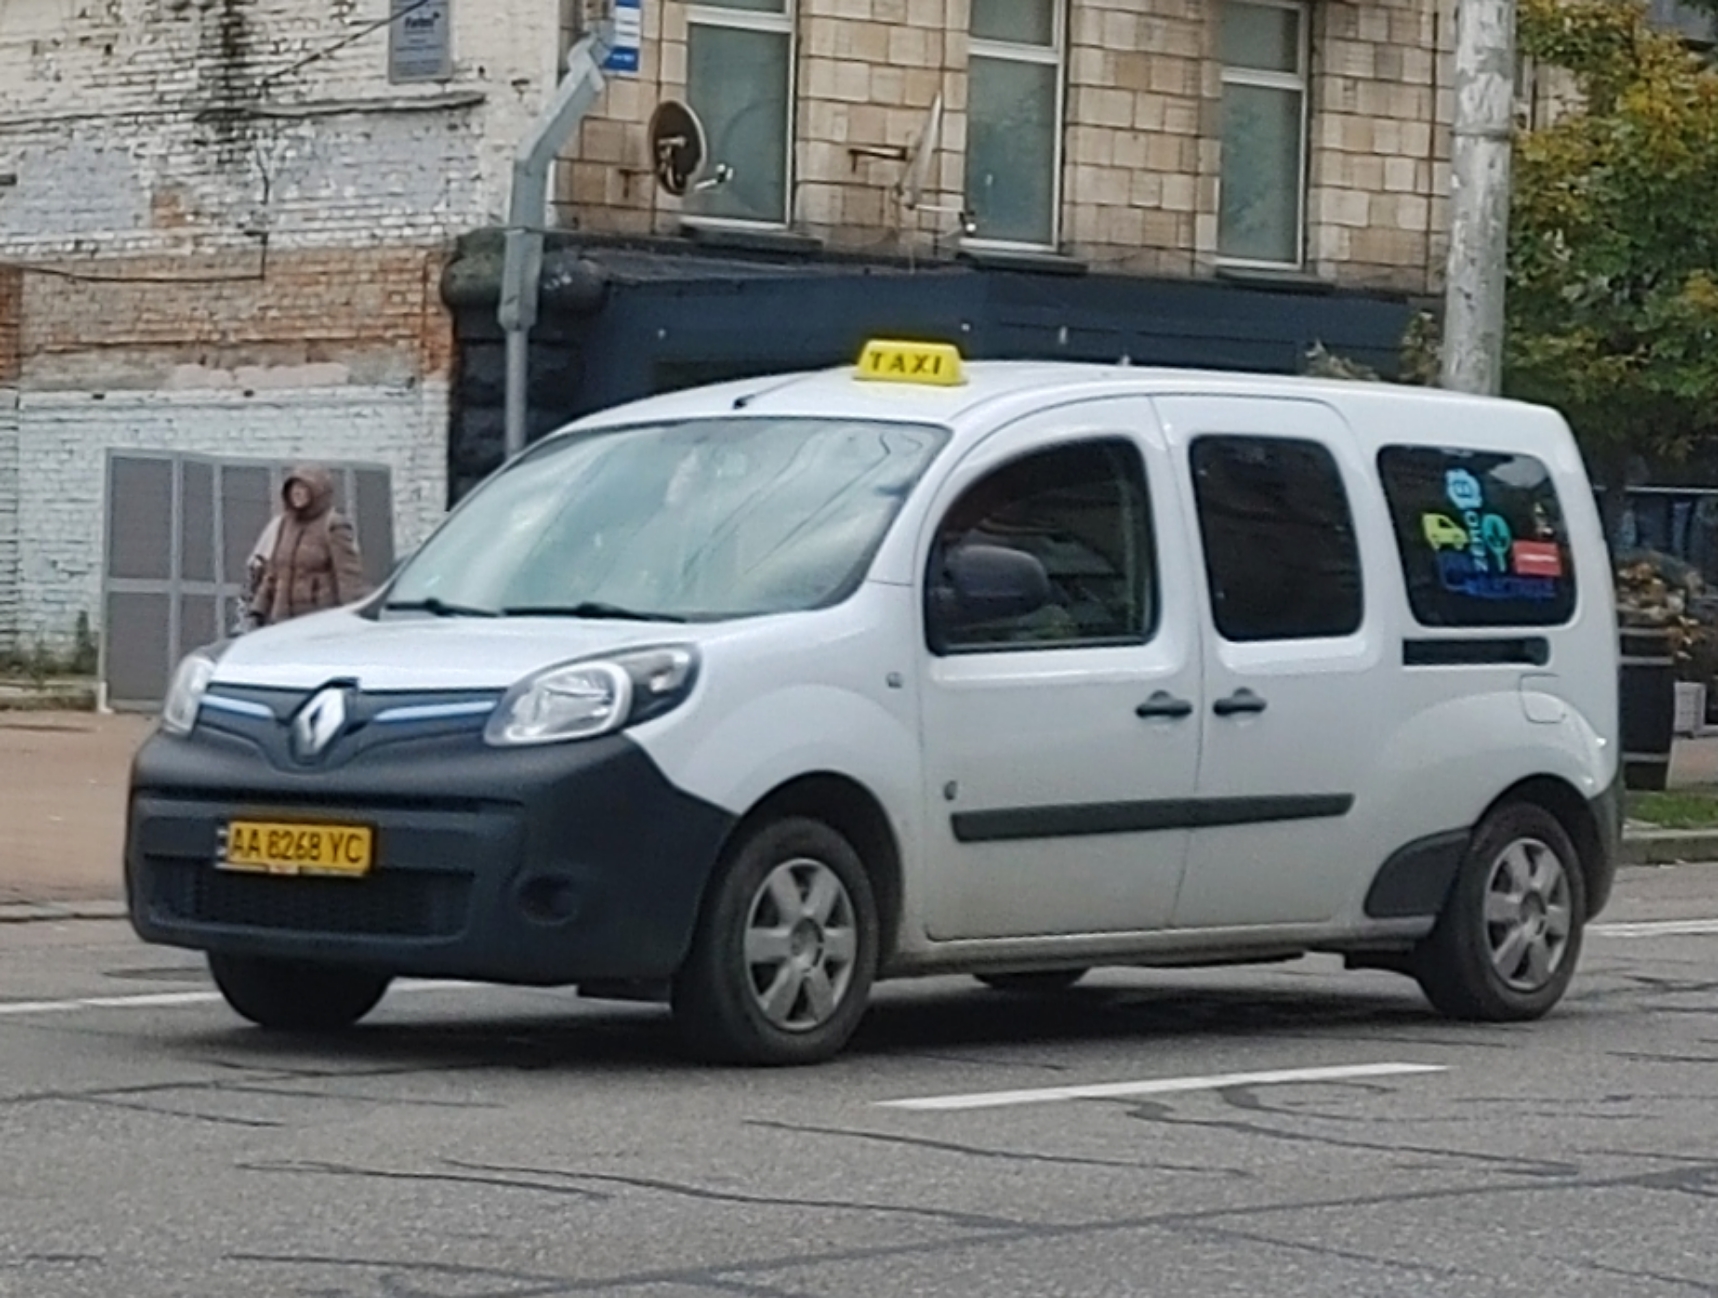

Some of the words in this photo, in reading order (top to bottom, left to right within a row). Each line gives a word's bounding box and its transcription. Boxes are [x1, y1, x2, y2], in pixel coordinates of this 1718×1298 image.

[870, 351, 943, 375] TAXI
[230, 828, 261, 859] AA
[267, 830, 322, 861] 8268
[329, 832, 364, 864] YC
